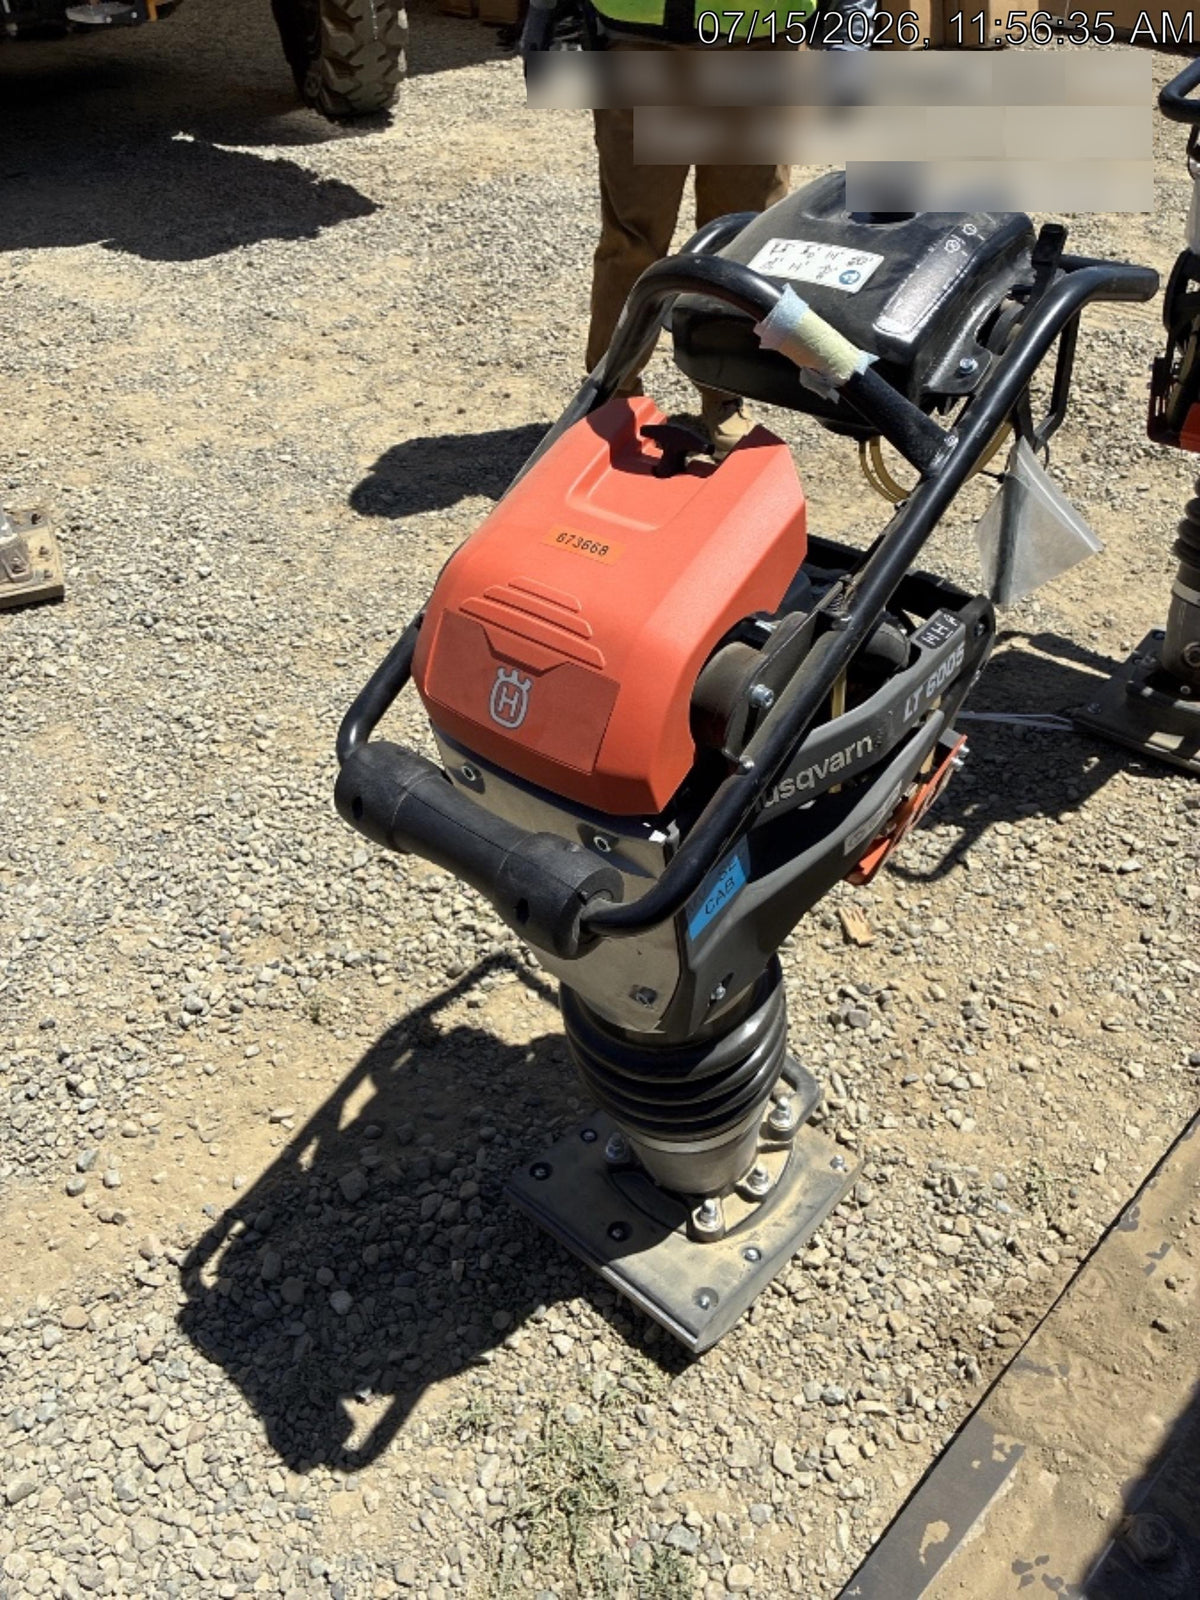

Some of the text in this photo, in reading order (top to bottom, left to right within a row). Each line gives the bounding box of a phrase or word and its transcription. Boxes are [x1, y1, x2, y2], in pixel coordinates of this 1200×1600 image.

[555, 531, 610, 556] 673668
[903, 685, 923, 722] LT
[763, 734, 875, 809] usqvarn
[704, 876, 736, 915] CAB
